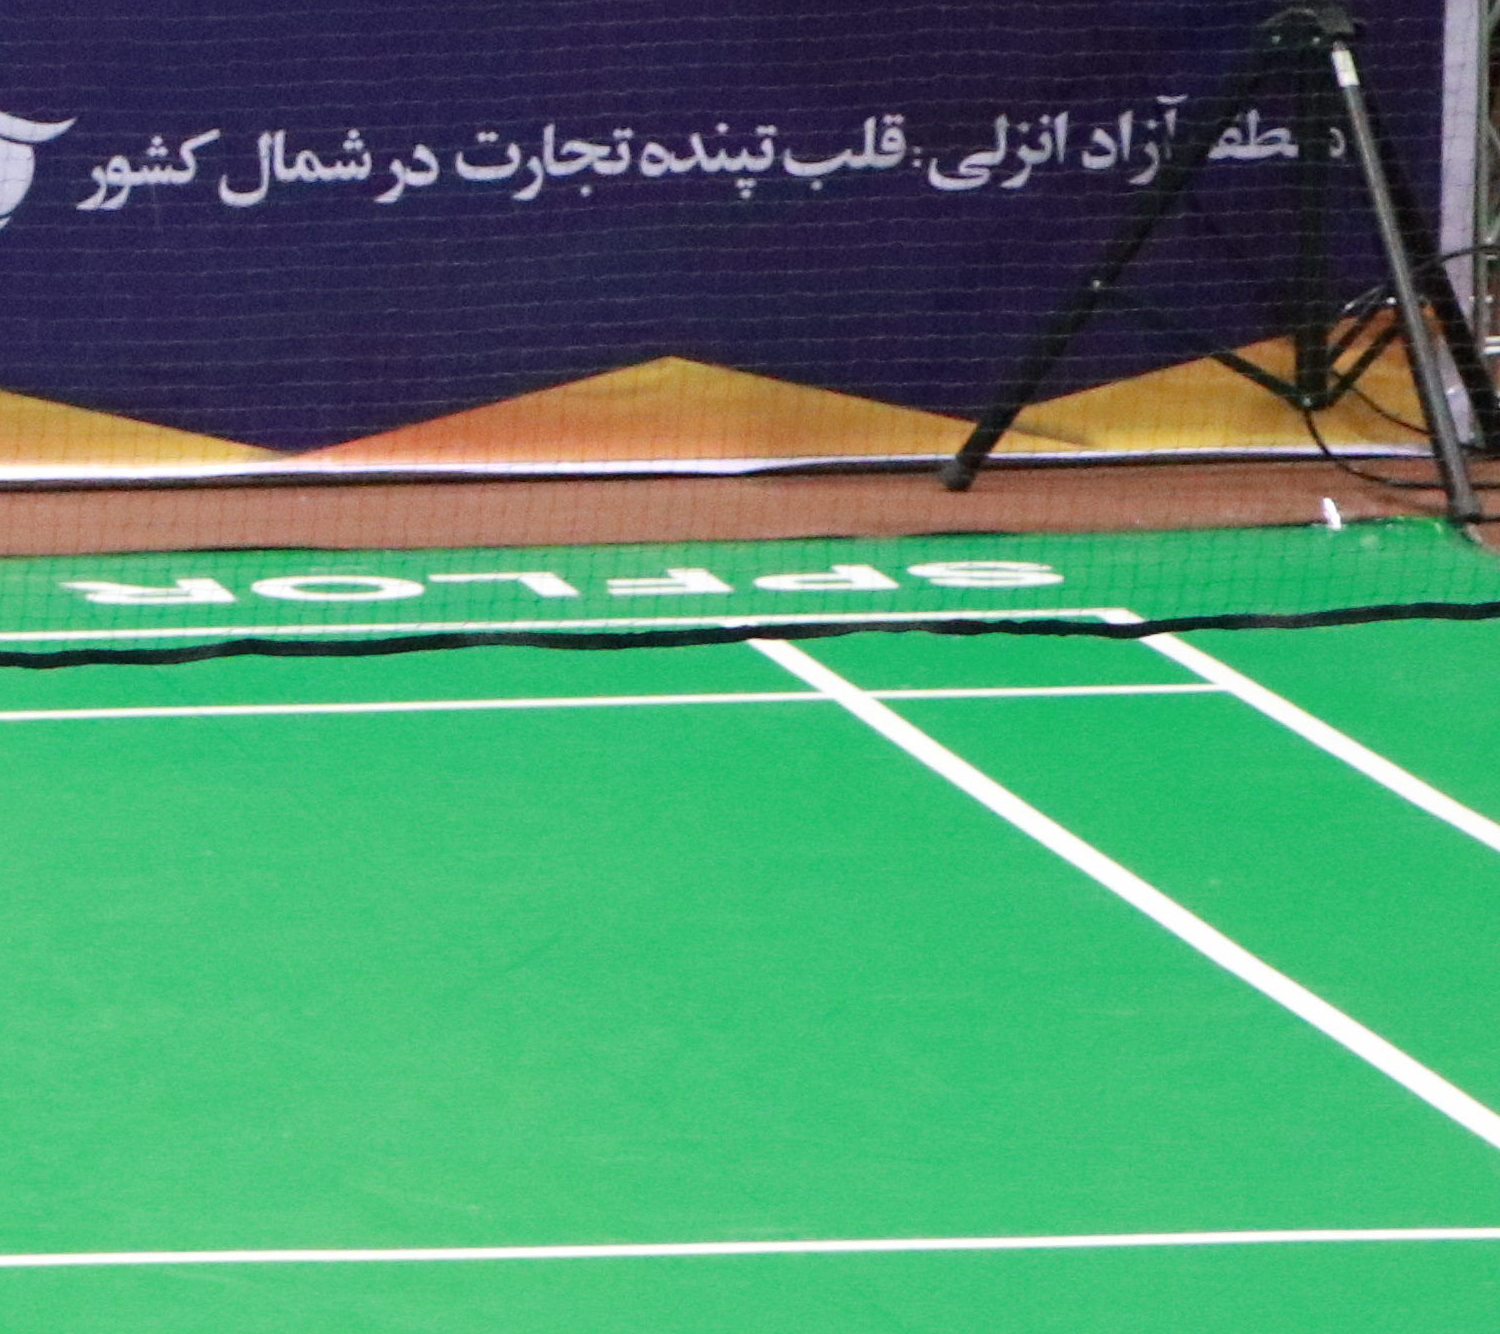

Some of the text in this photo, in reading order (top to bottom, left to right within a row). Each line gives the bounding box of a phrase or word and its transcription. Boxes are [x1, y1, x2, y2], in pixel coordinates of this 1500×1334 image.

[76, 128, 221, 210] کشور
[218, 127, 372, 208] شمال
[373, 143, 440, 204] در
[455, 123, 634, 201] تجارت
[640, 122, 779, 200] تپنده
[782, 114, 906, 192] قلب
